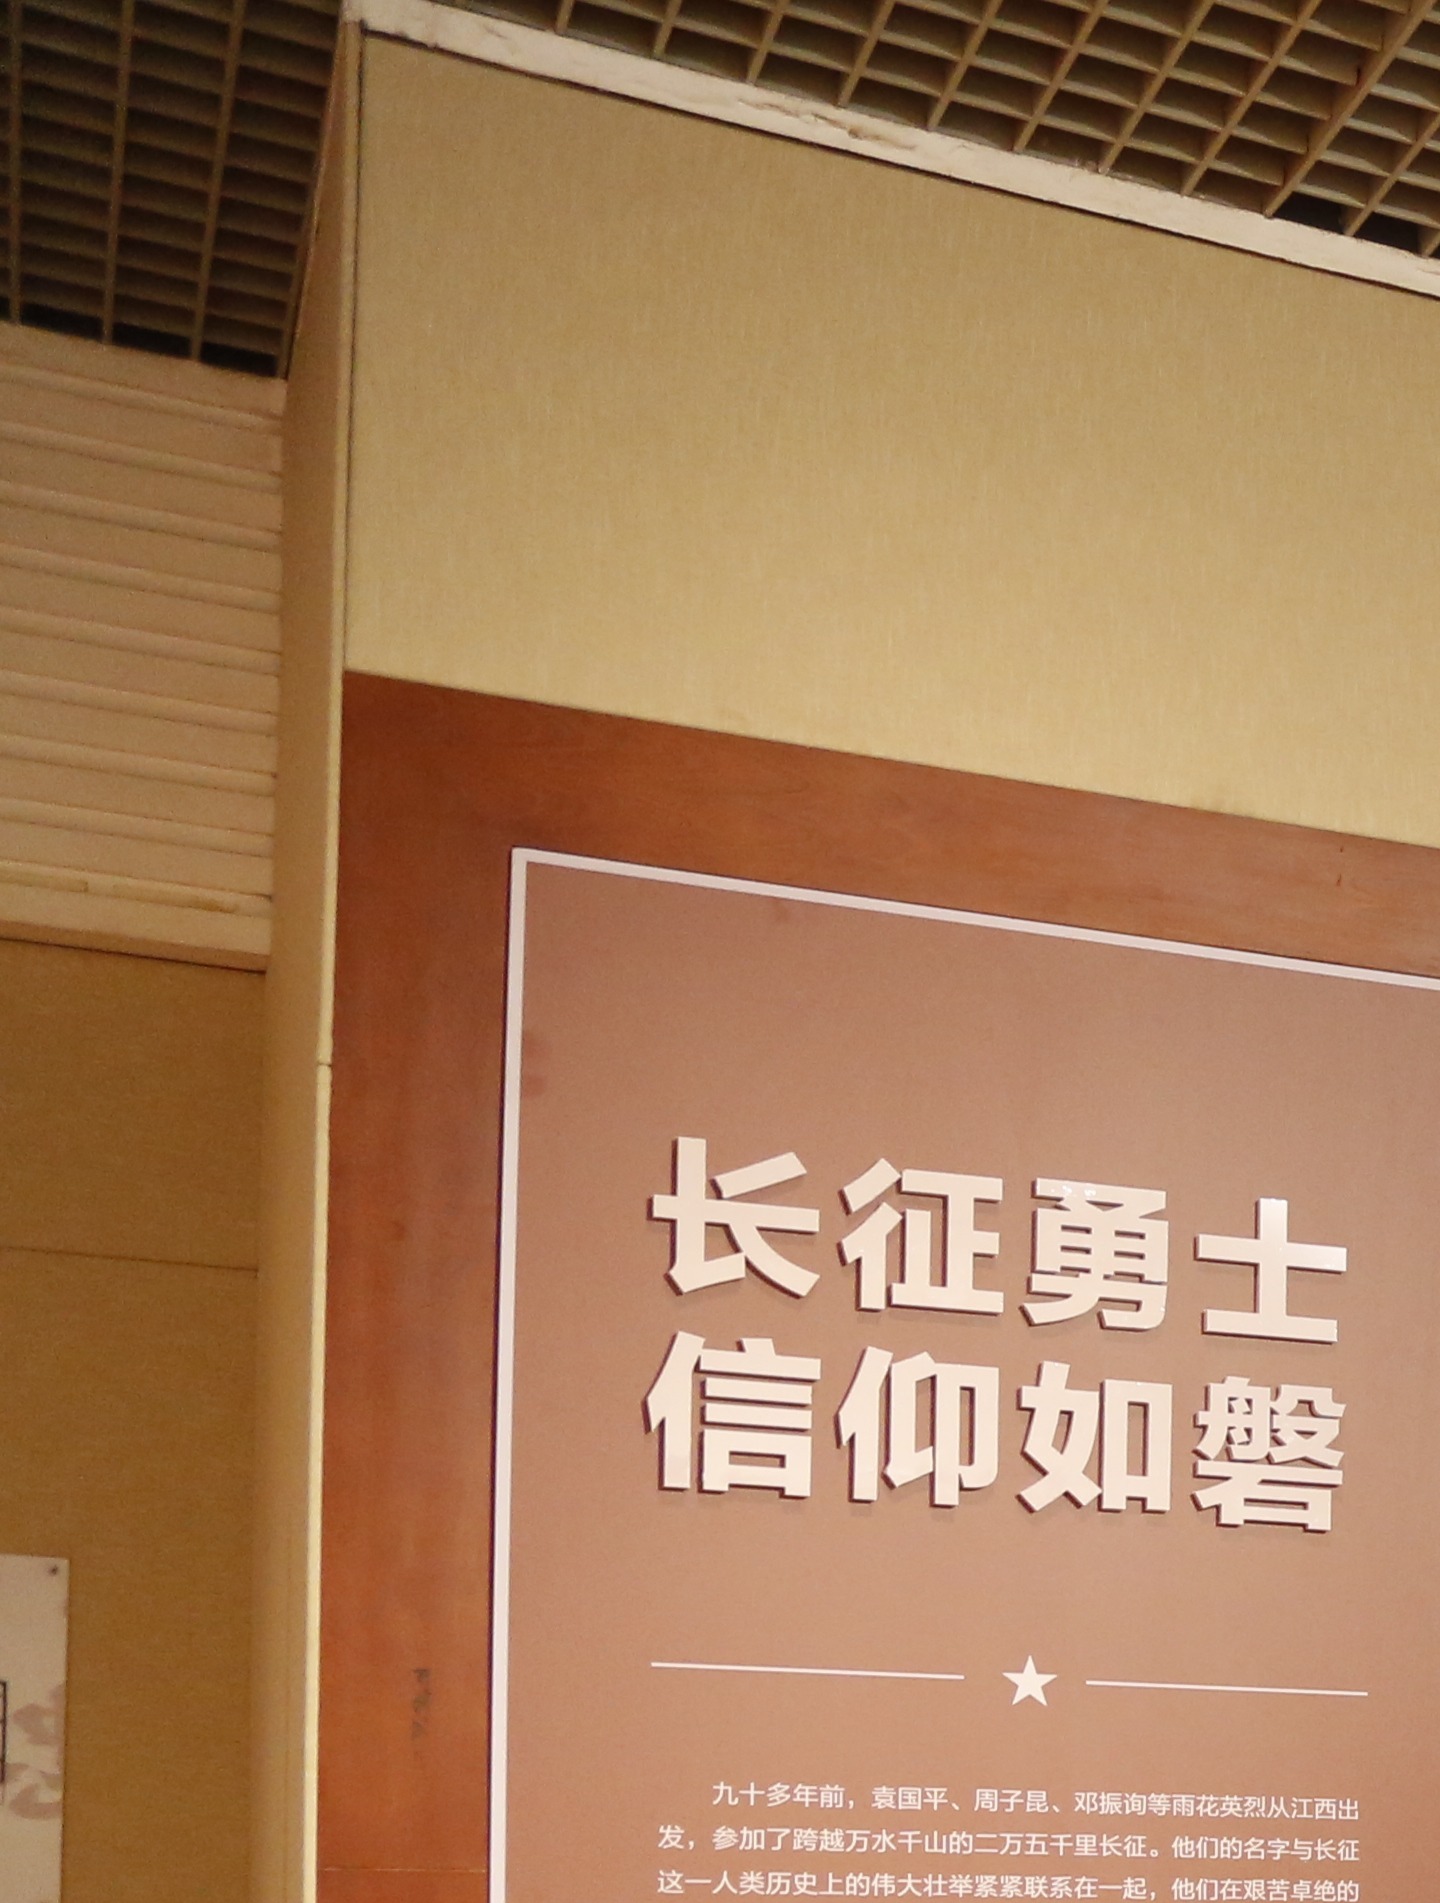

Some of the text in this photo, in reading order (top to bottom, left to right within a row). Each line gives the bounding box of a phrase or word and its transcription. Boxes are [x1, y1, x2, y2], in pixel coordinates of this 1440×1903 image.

[650, 1135, 1347, 1345] 长征勇士
[645, 1330, 1345, 1533] 信仰如磐
[711, 1780, 1360, 1822] 九十多年前，袁国平、周子昆、邓振询等雨花英烈从江西出
[658, 1824, 1360, 1863] 发，参加了跨越万水千山的二万五千里长征。他们的名字与长征
[658, 1870, 1360, 1903] 这一人类历史上的伟大壮举紧紧联系在一起，他们在艰苦卓绝的
